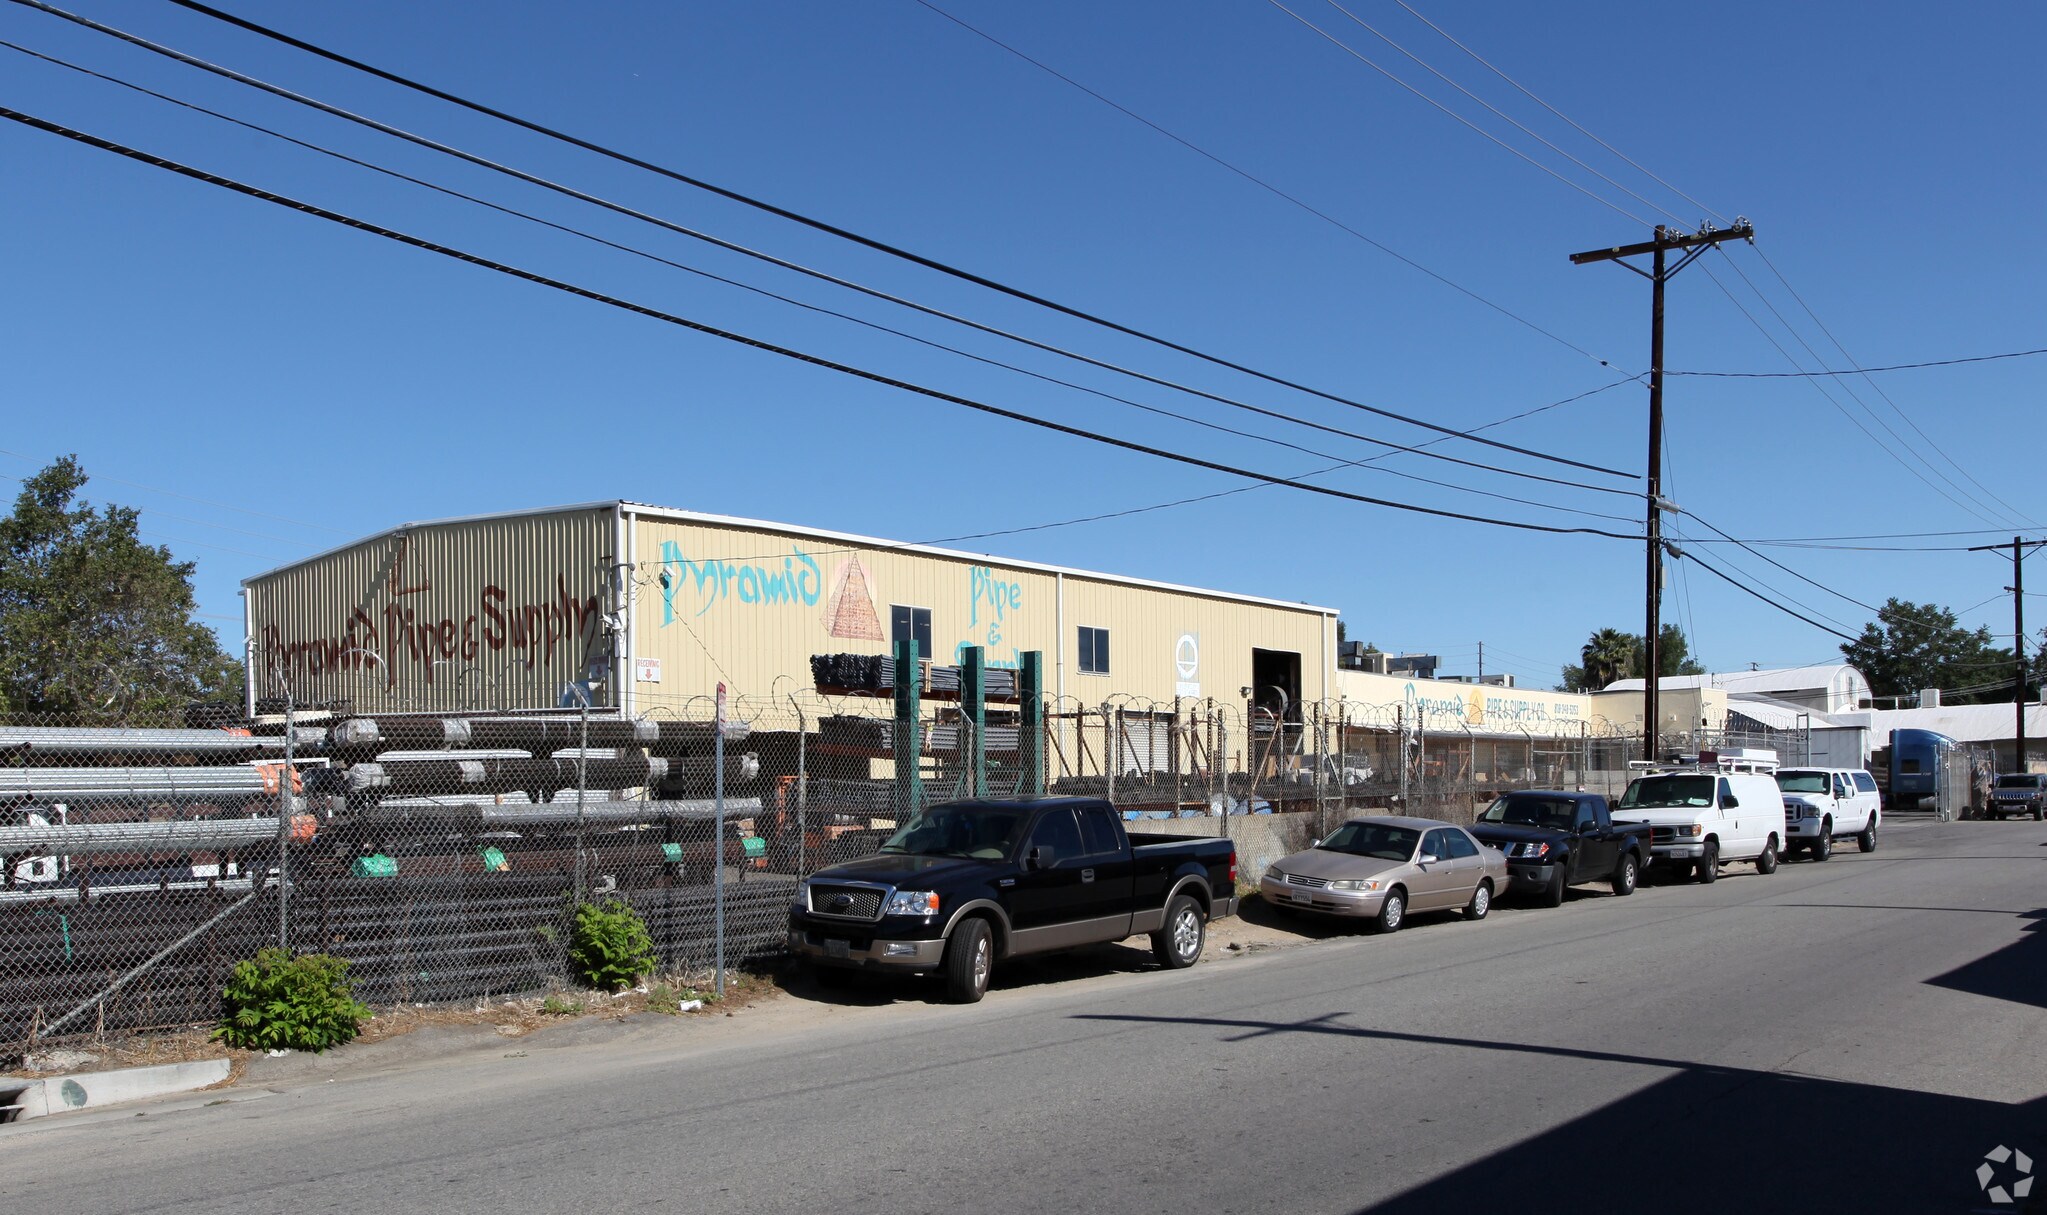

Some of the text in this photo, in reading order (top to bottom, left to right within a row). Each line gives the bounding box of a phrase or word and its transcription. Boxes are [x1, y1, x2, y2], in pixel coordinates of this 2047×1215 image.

[660, 540, 821, 628] Pyramid
[969, 565, 1021, 629] Pipe
[263, 604, 380, 697] Pyramid
[384, 601, 456, 692] Pipe
[482, 573, 598, 671] Supply
[987, 621, 1003, 646] &
[637, 658, 659, 668] RECEIVING
[1486, 697, 1502, 719] PIPE
[1511, 699, 1537, 721] SUPPLY
